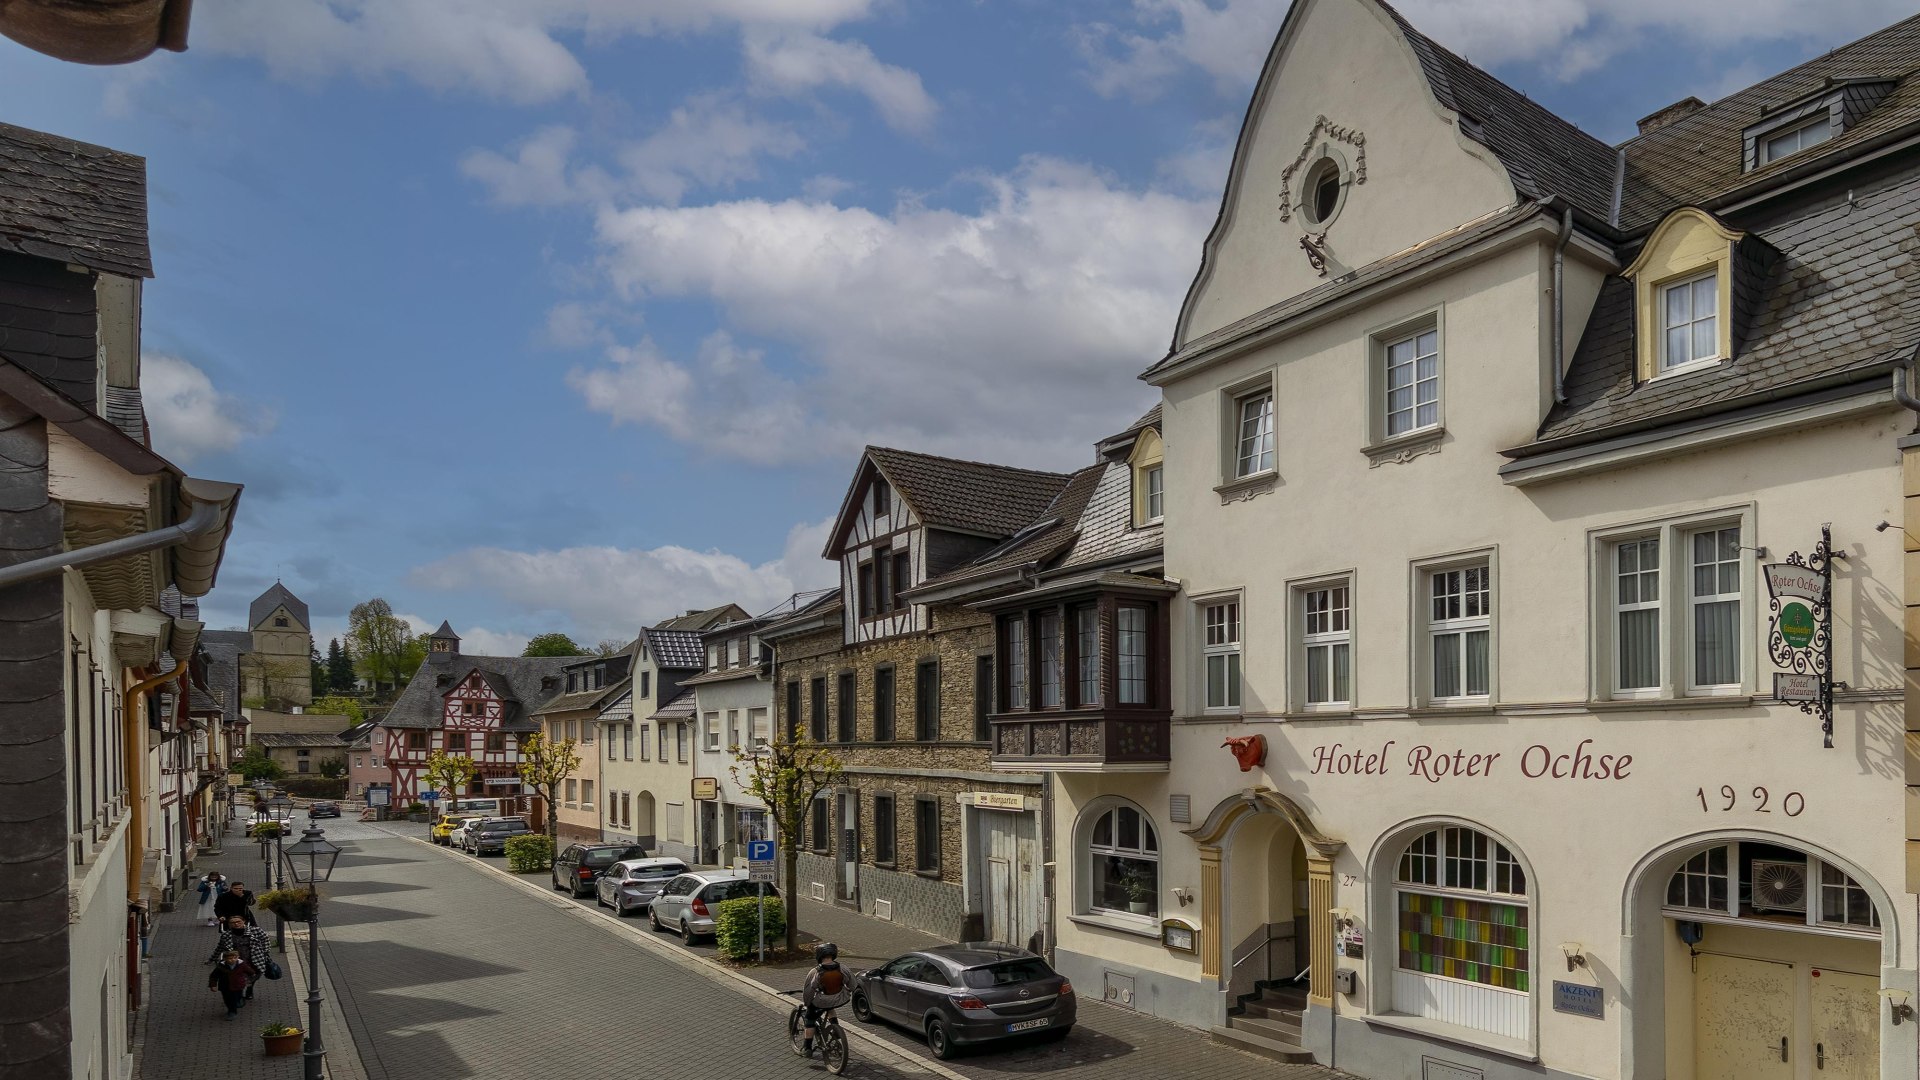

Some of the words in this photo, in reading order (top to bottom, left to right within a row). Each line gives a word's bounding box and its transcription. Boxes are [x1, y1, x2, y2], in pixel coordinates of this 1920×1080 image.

[1772, 575, 1795, 588] Roter
[1797, 577, 1821, 593] Ochse
[1789, 678, 1809, 688] Hotel
[1781, 687, 1816, 696] Restaurant
[1310, 740, 1395, 775] Hotel
[1407, 745, 1501, 783] Roter
[1520, 738, 1633, 780] Ochse
[990, 794, 1018, 806] Biergarten
[1696, 784, 1805, 817] 1920
[754, 844, 768, 858] P
[1344, 876, 1356, 886] 27
[1560, 984, 1597, 998] AKZENT
